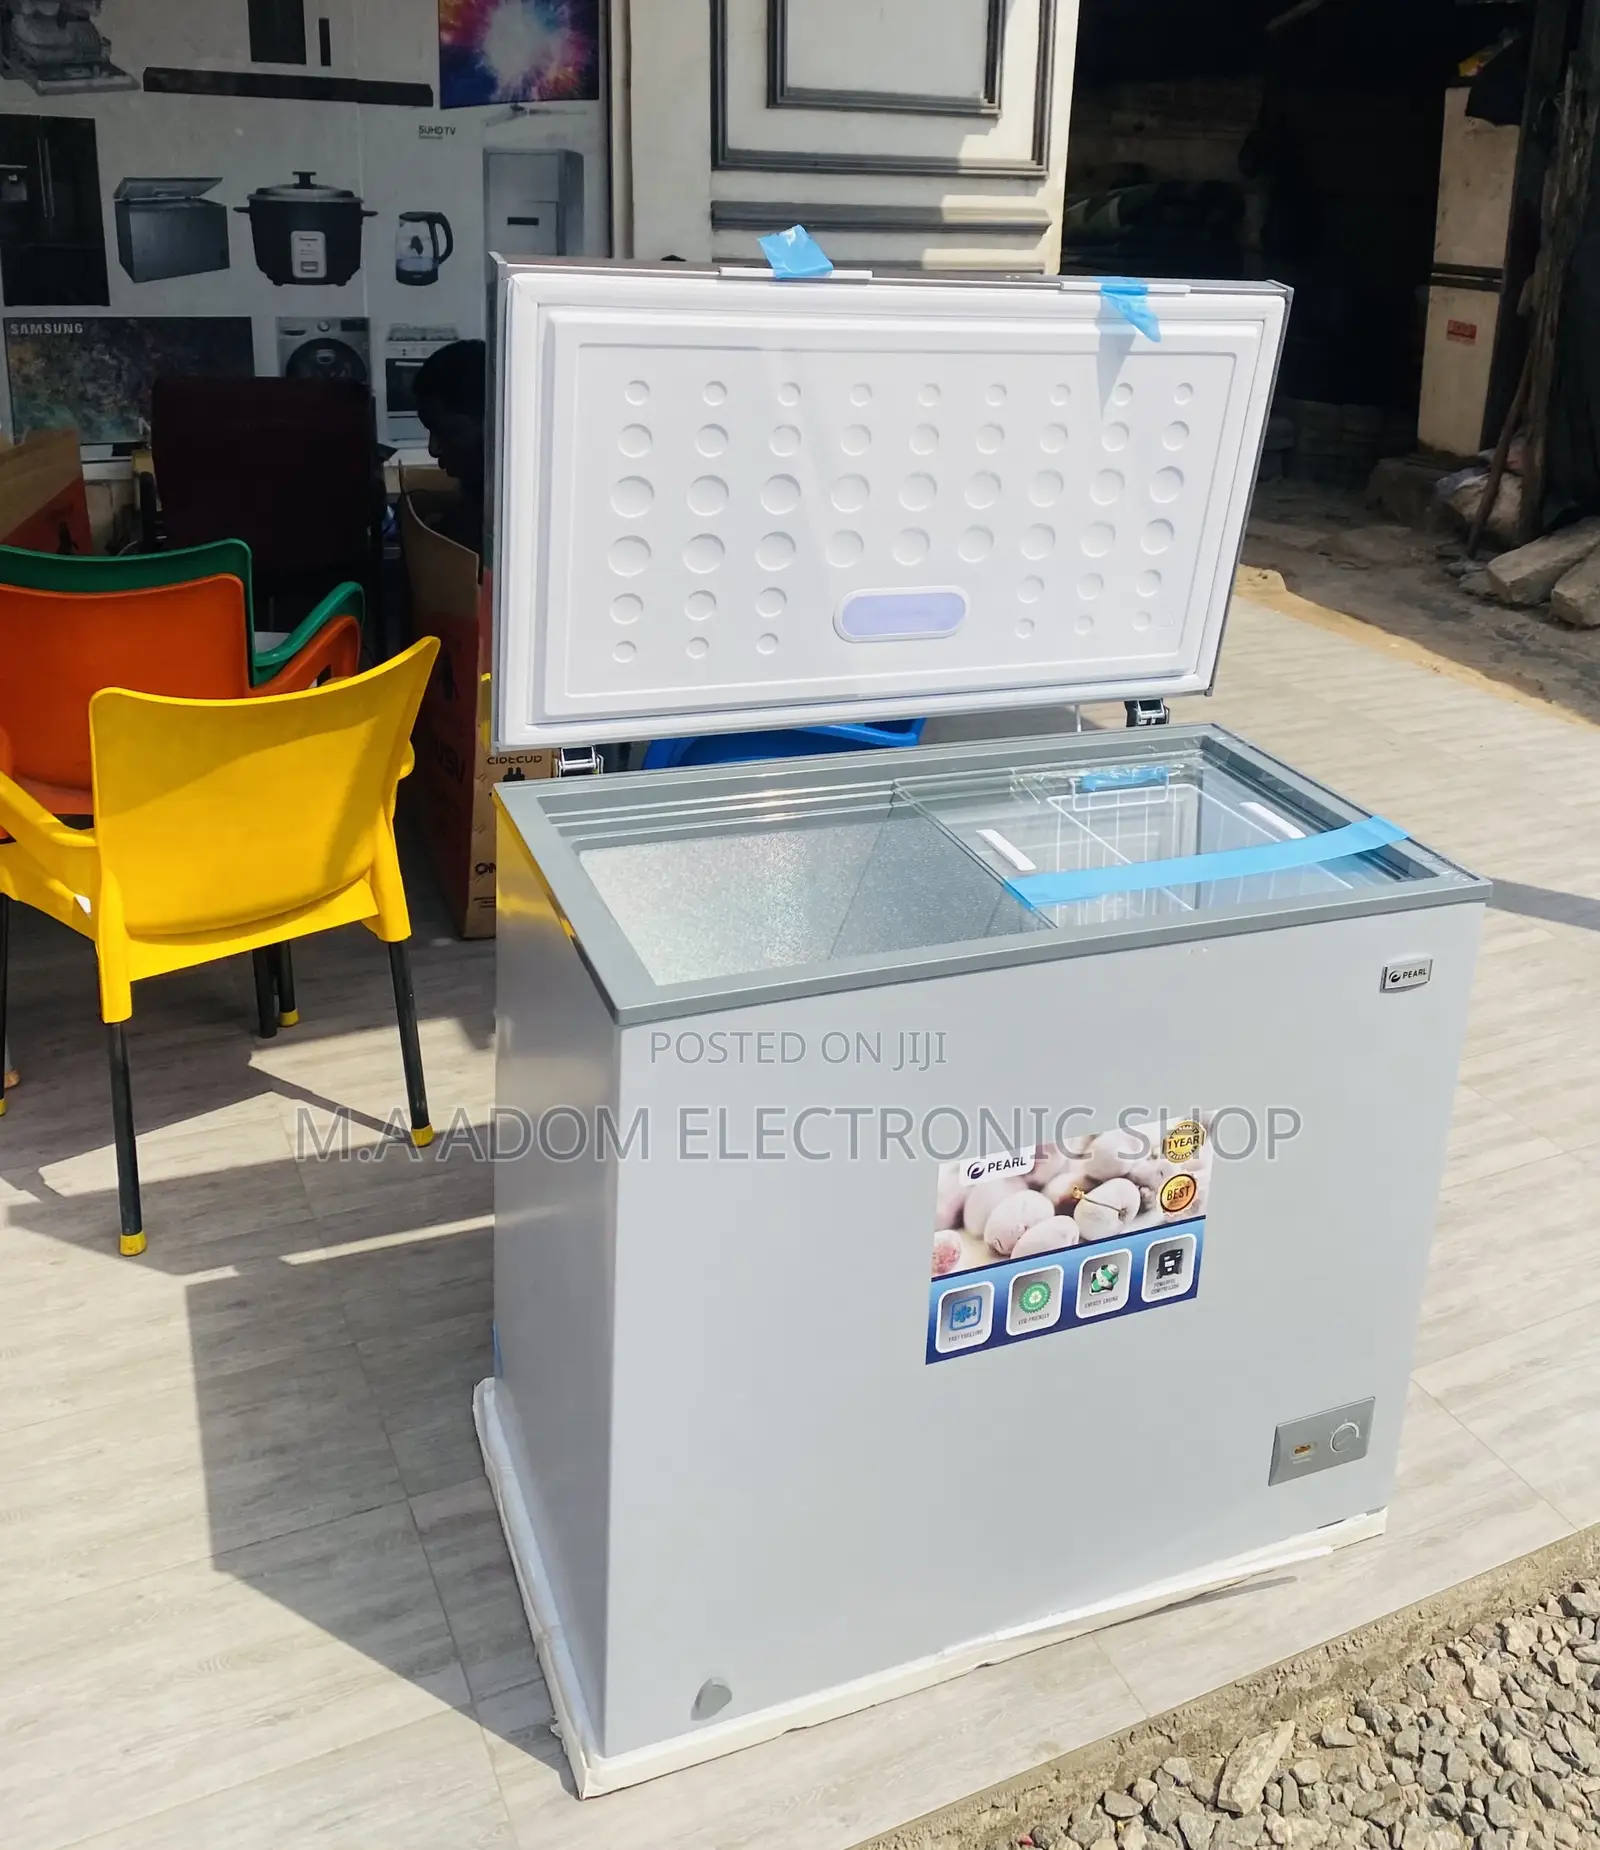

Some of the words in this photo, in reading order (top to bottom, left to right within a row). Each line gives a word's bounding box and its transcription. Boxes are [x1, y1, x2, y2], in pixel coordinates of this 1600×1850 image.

[10, 323, 84, 335] SAMSUNG
[1402, 967, 1427, 979] PEARL
[1173, 1135, 1200, 1149] YEAR
[987, 1156, 1027, 1173] PEARL
[1166, 1185, 1191, 1201] BEST
